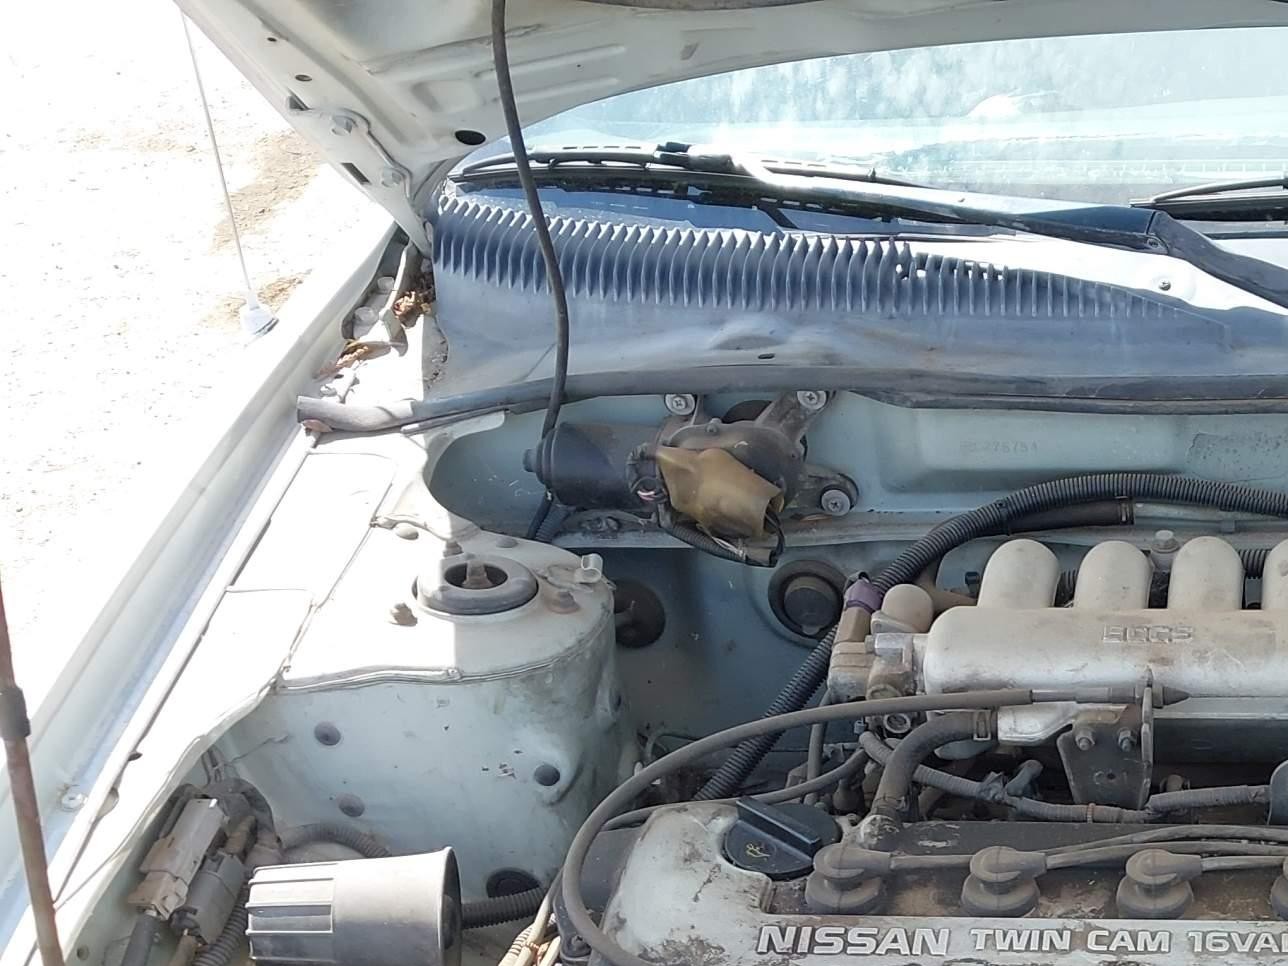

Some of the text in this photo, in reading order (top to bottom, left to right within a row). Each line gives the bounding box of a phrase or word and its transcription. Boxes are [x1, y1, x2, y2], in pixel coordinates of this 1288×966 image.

[757, 926, 950, 955] NISSAN
[969, 928, 1072, 952] TWIN
[1086, 929, 1171, 953] CAM
